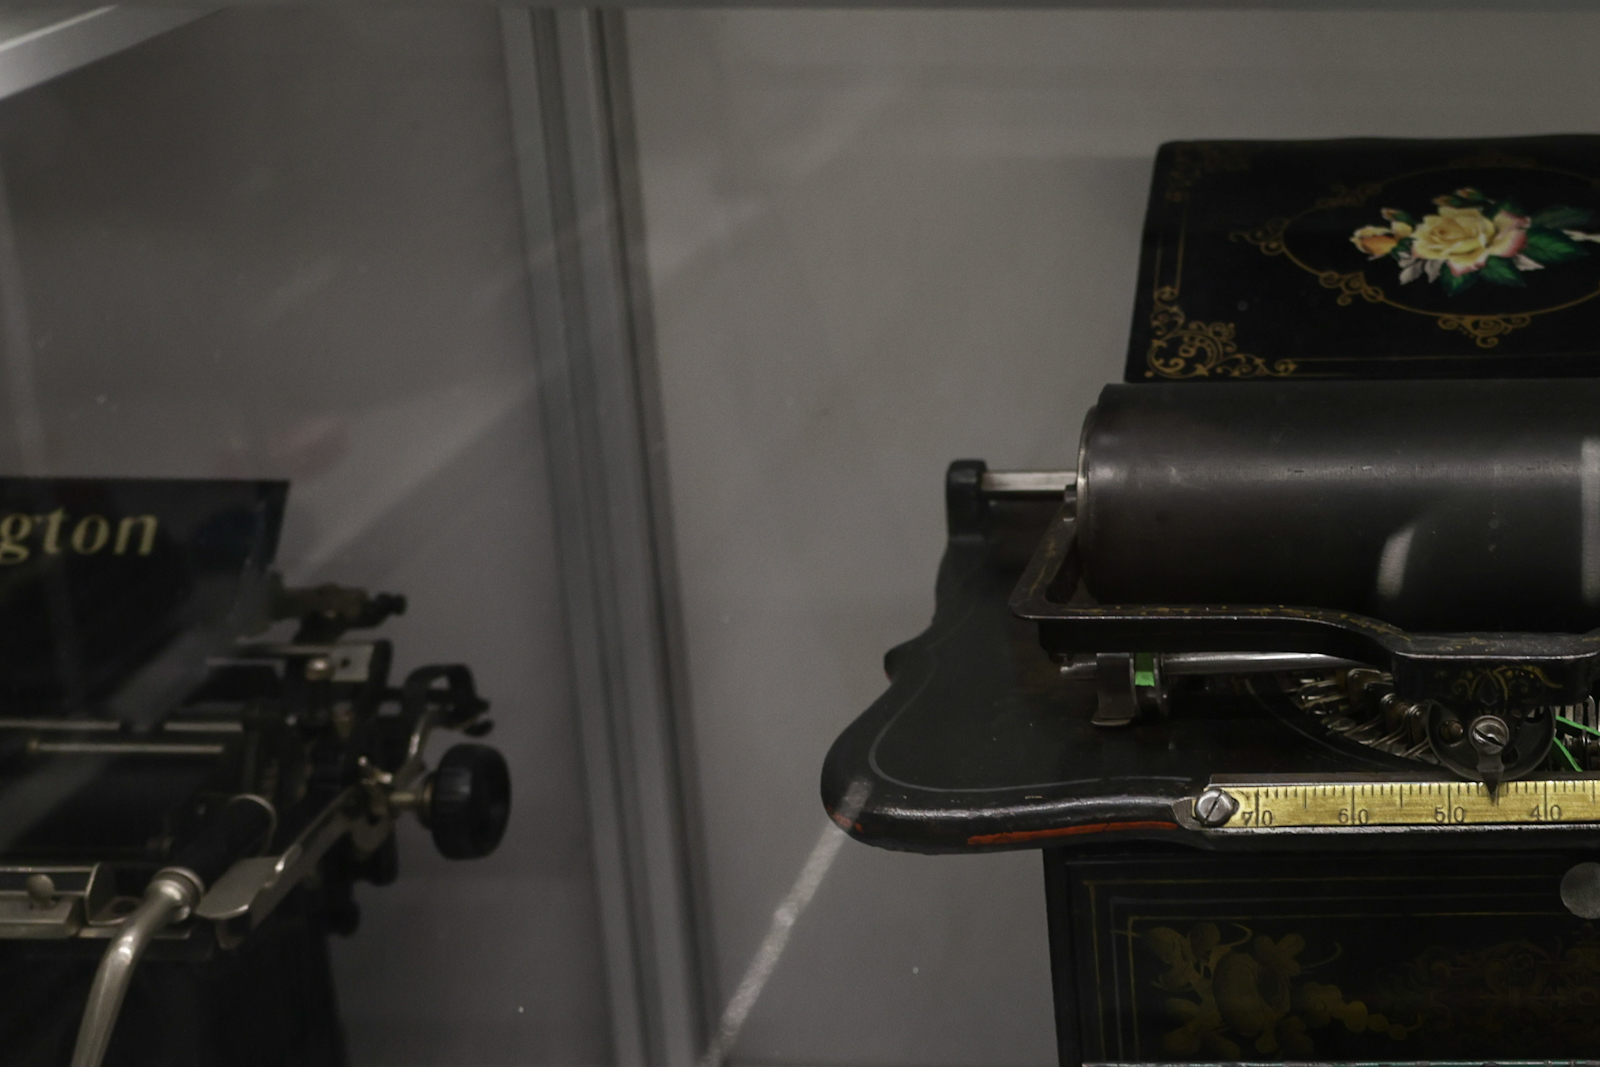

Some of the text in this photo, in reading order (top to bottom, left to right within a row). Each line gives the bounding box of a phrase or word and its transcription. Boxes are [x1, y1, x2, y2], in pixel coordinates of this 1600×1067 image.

[1338, 808, 1369, 825] 60
[1434, 806, 1465, 823] 50
[1530, 804, 1561, 821] 40
